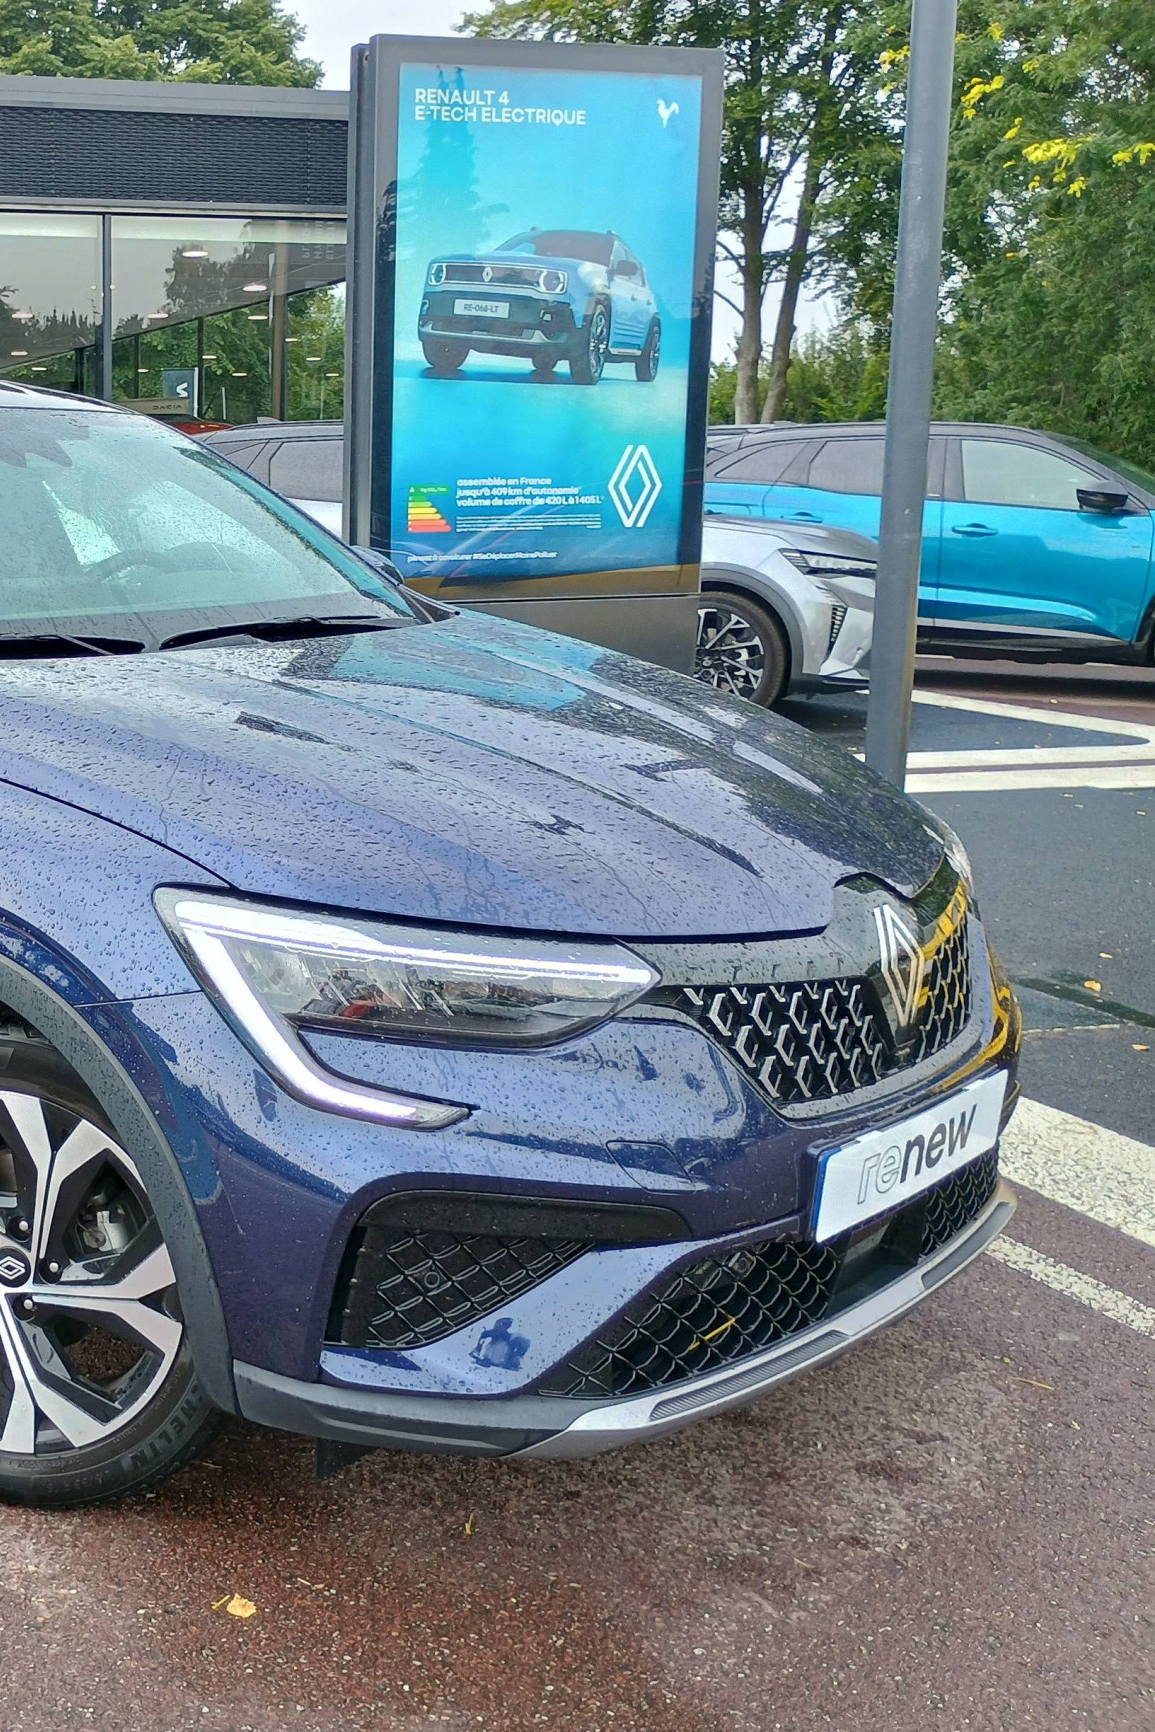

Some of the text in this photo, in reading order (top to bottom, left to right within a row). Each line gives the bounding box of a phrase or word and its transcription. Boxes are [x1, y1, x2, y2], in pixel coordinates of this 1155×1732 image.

[415, 88, 510, 106] RENAULT 4
[414, 105, 587, 127] E-TECH ELECTRIQUE
[520, 476, 552, 486] France
[508, 487, 523, 496] km
[857, 1104, 977, 1205] renew
